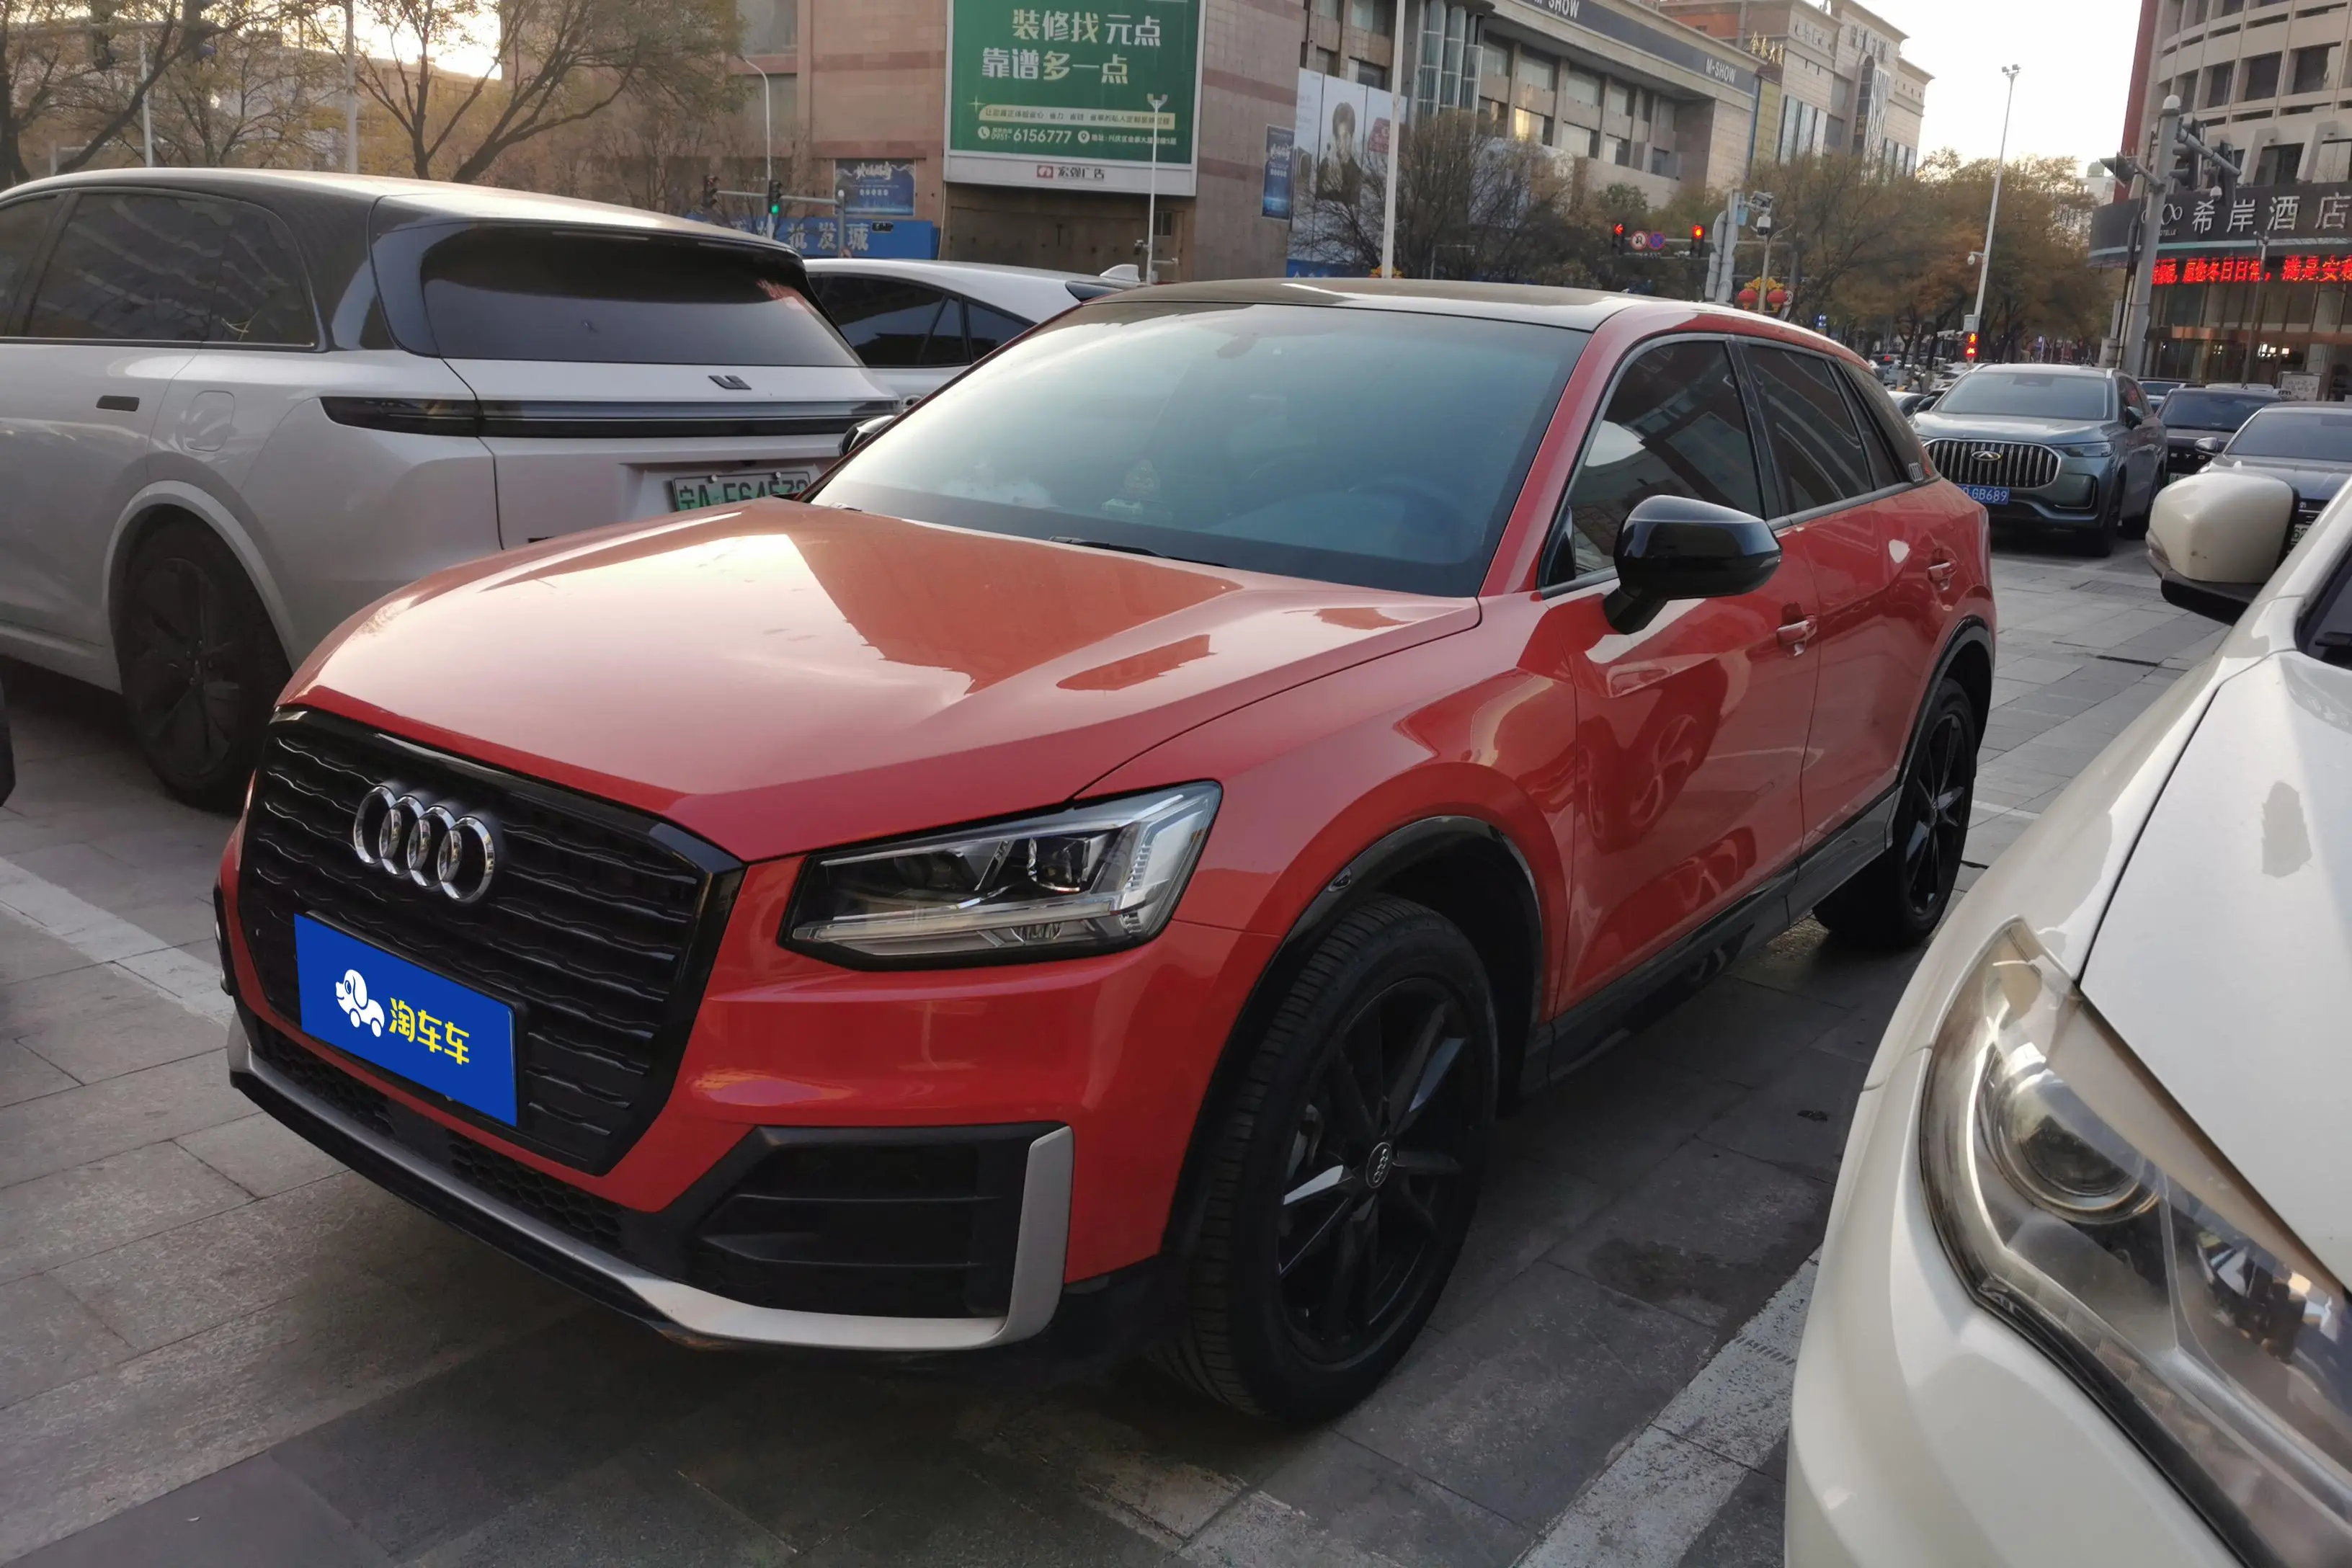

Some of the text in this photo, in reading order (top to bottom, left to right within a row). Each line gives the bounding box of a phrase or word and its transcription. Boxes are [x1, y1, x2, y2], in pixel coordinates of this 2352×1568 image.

[982, 47, 1128, 84] 靠谱多一点
[1013, 128, 1072, 144] 6156777
[2192, 192, 2351, 234] 希岸酒店
